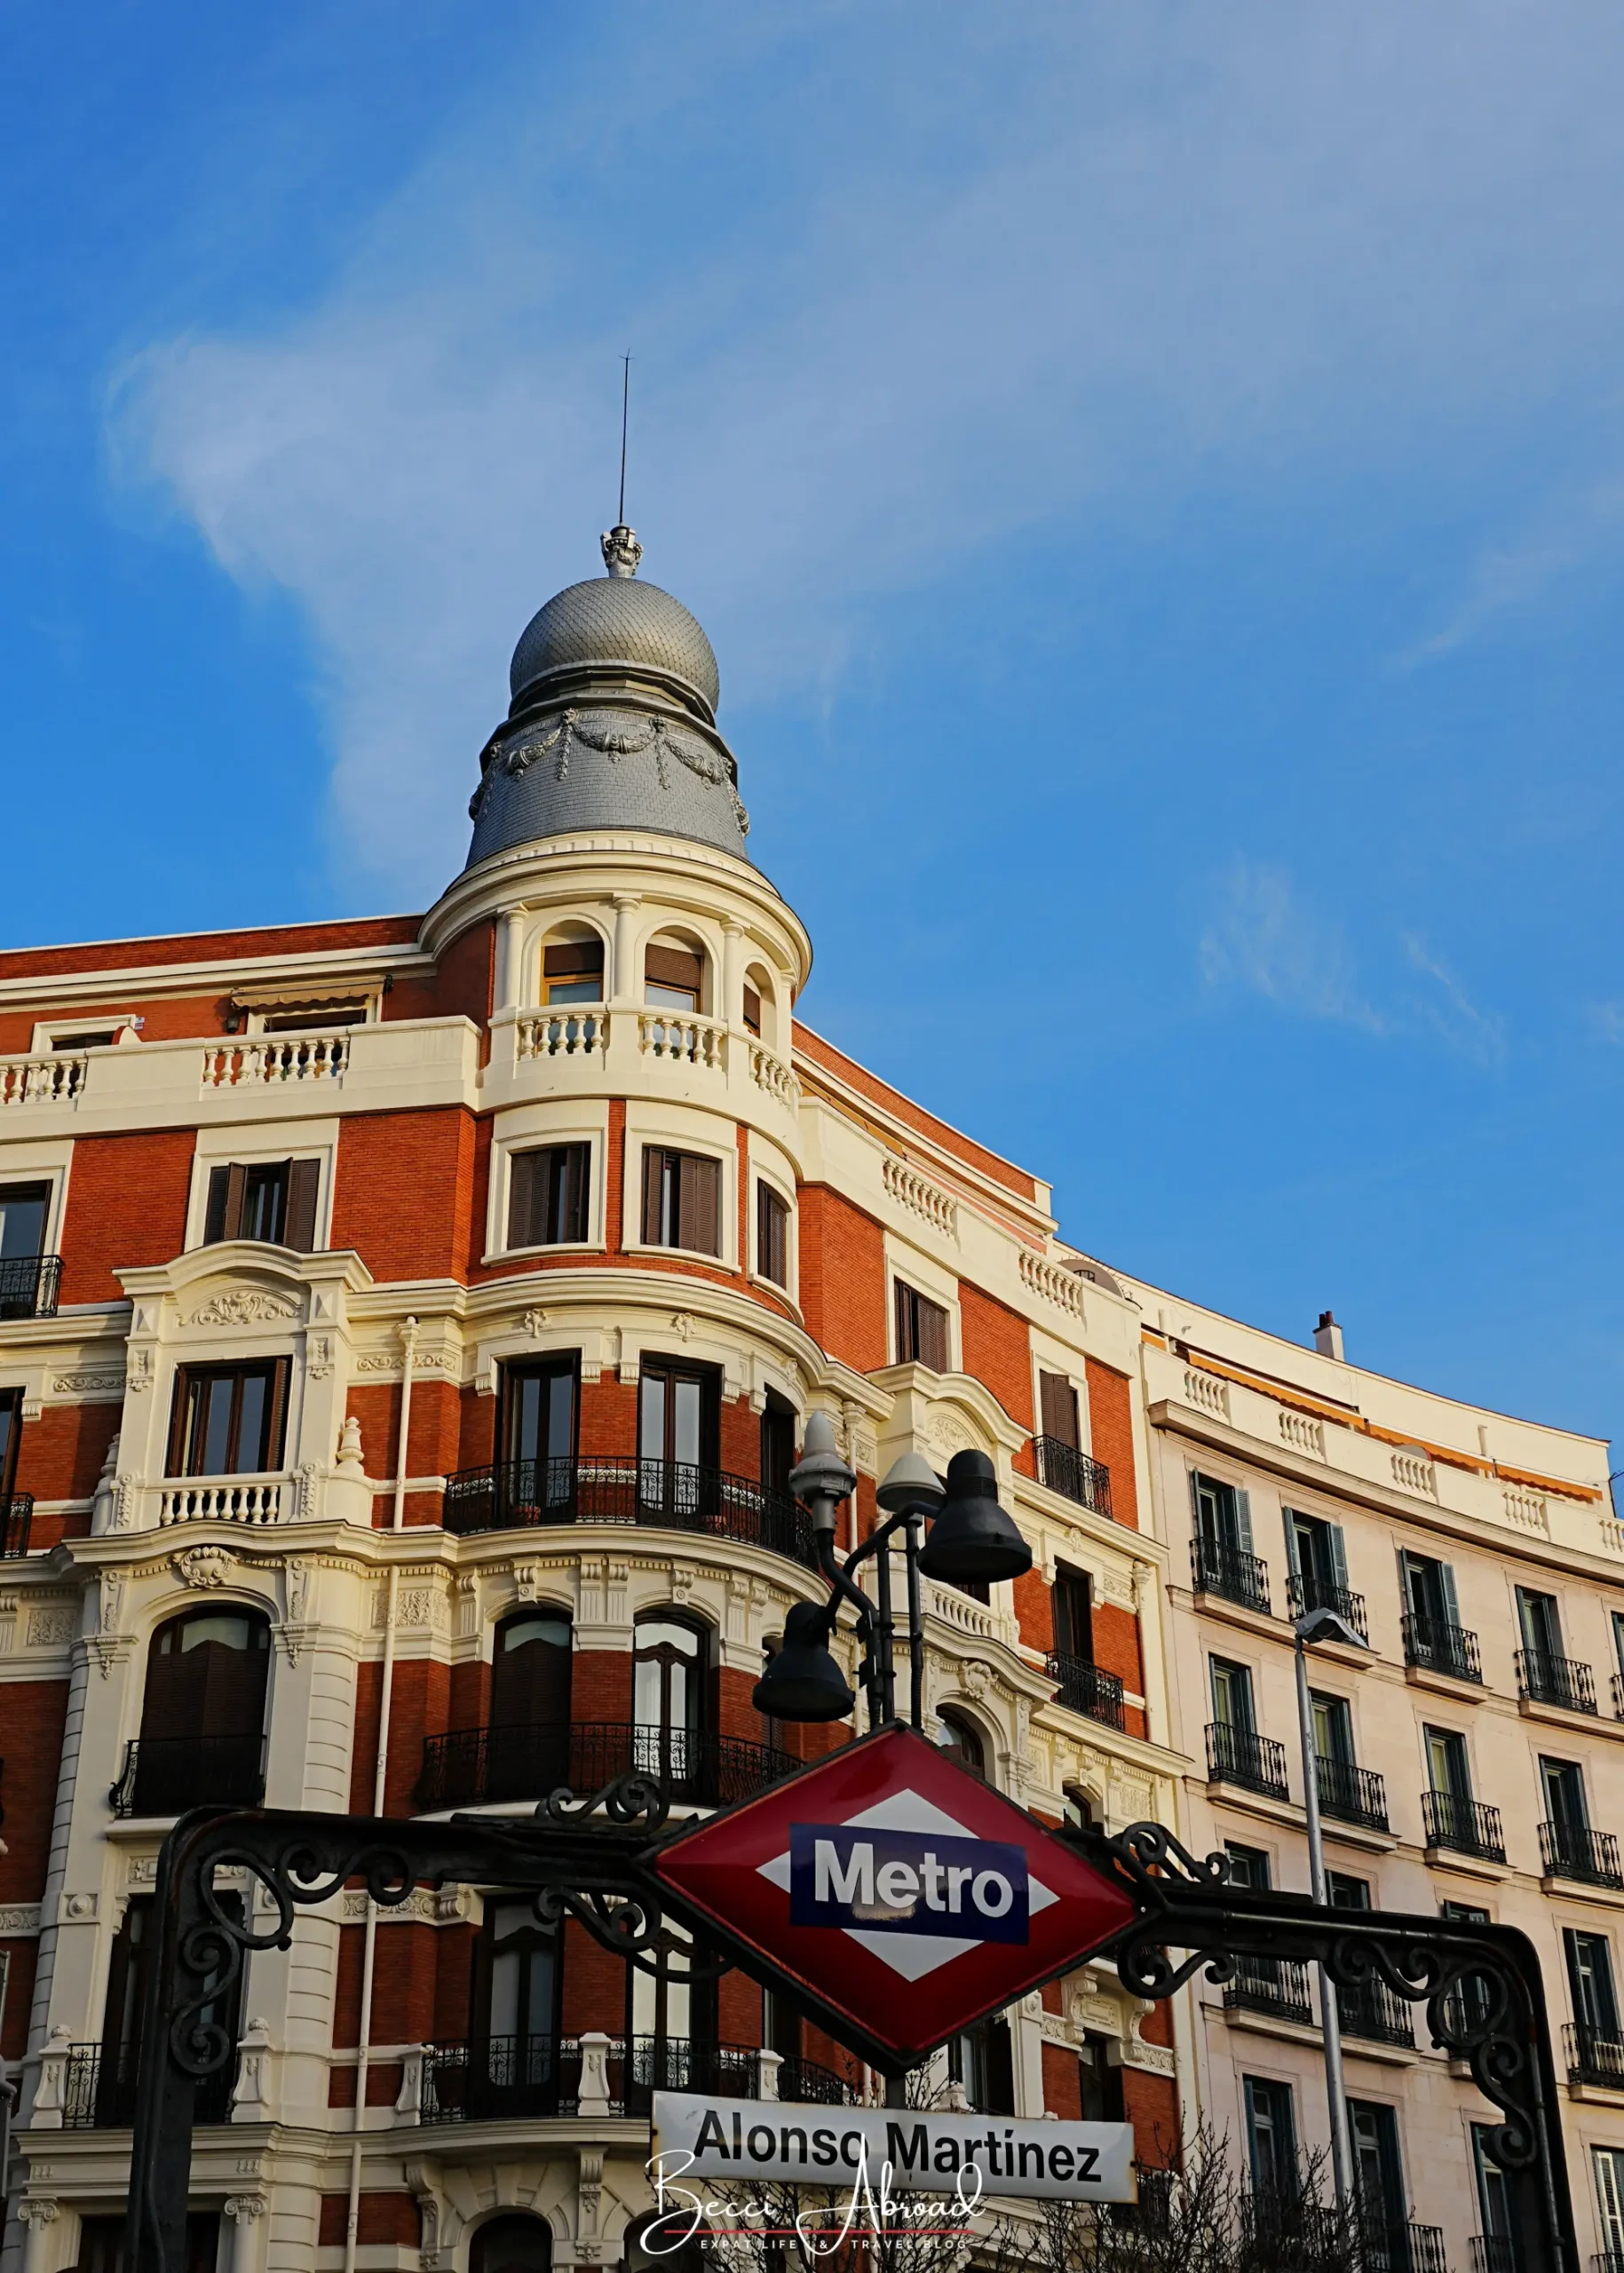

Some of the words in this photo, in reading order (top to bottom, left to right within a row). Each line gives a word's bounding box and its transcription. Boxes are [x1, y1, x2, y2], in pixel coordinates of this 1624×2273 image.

[813, 1839, 1014, 1918] Metro
[693, 2110, 870, 2168] Alonso
[886, 2121, 1102, 2182] Martínez
